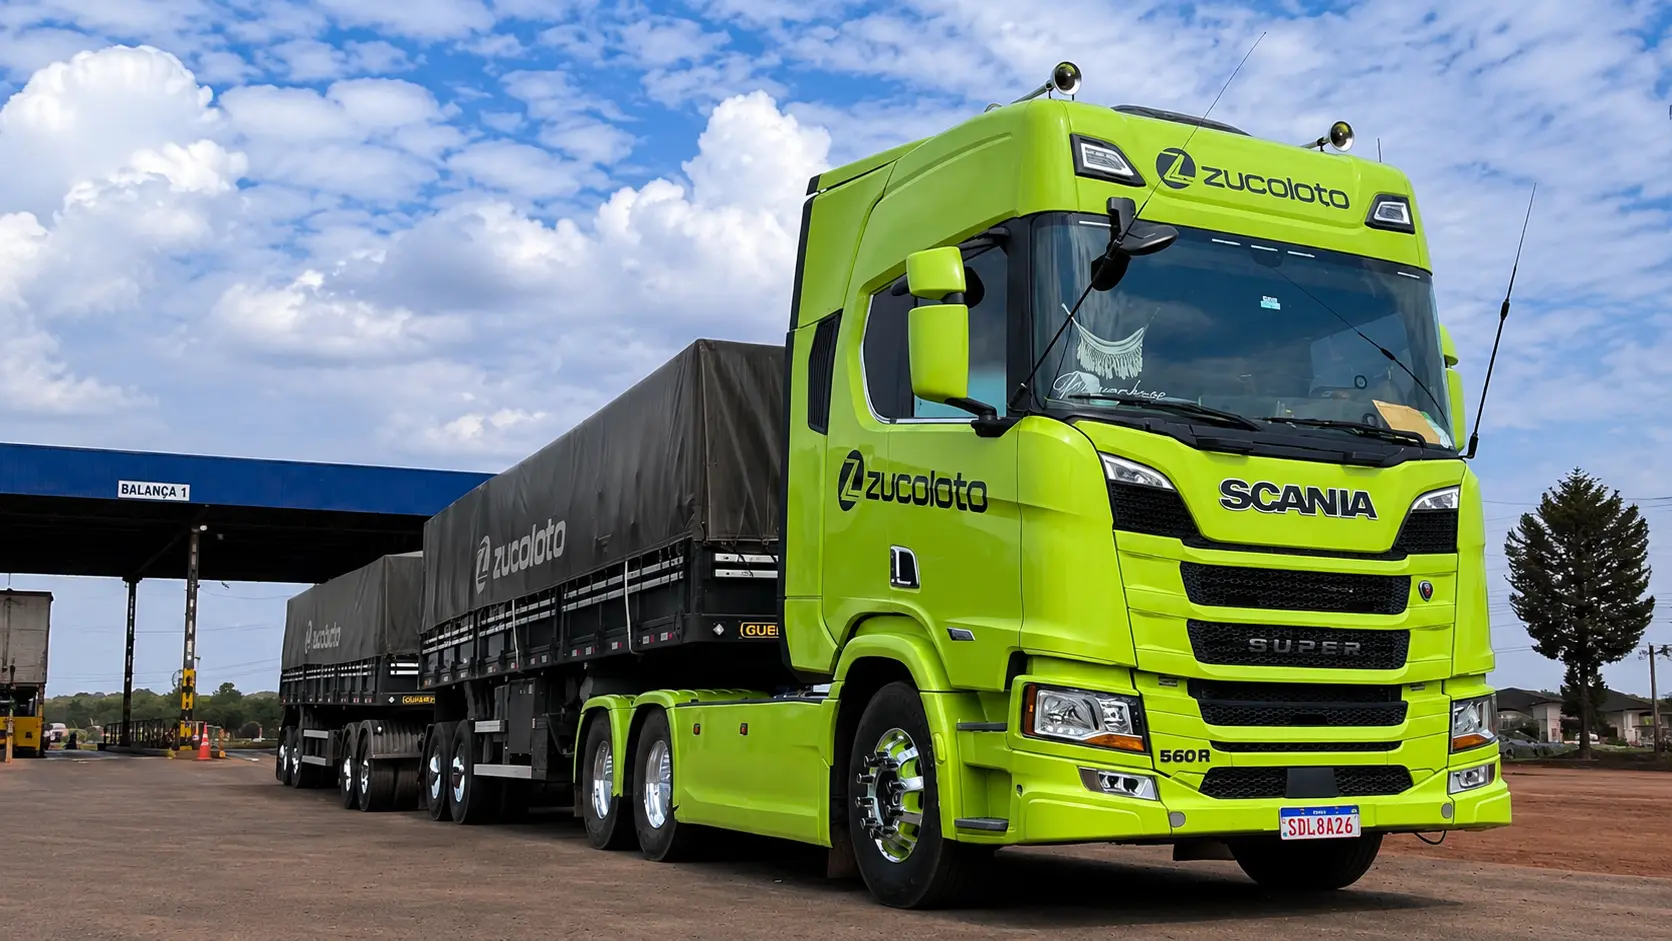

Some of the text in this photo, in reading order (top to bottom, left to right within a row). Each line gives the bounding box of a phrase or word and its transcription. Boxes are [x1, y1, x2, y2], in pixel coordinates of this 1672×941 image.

[1201, 166, 1350, 210] zucoloto
[121, 483, 187, 499] BALANÇA 1
[865, 470, 989, 514] zucoloto
[1219, 478, 1379, 520] SCANIA
[493, 518, 566, 579] zucoloto
[1248, 638, 1361, 656] SUPER
[1288, 816, 1353, 836] SDL8A26
